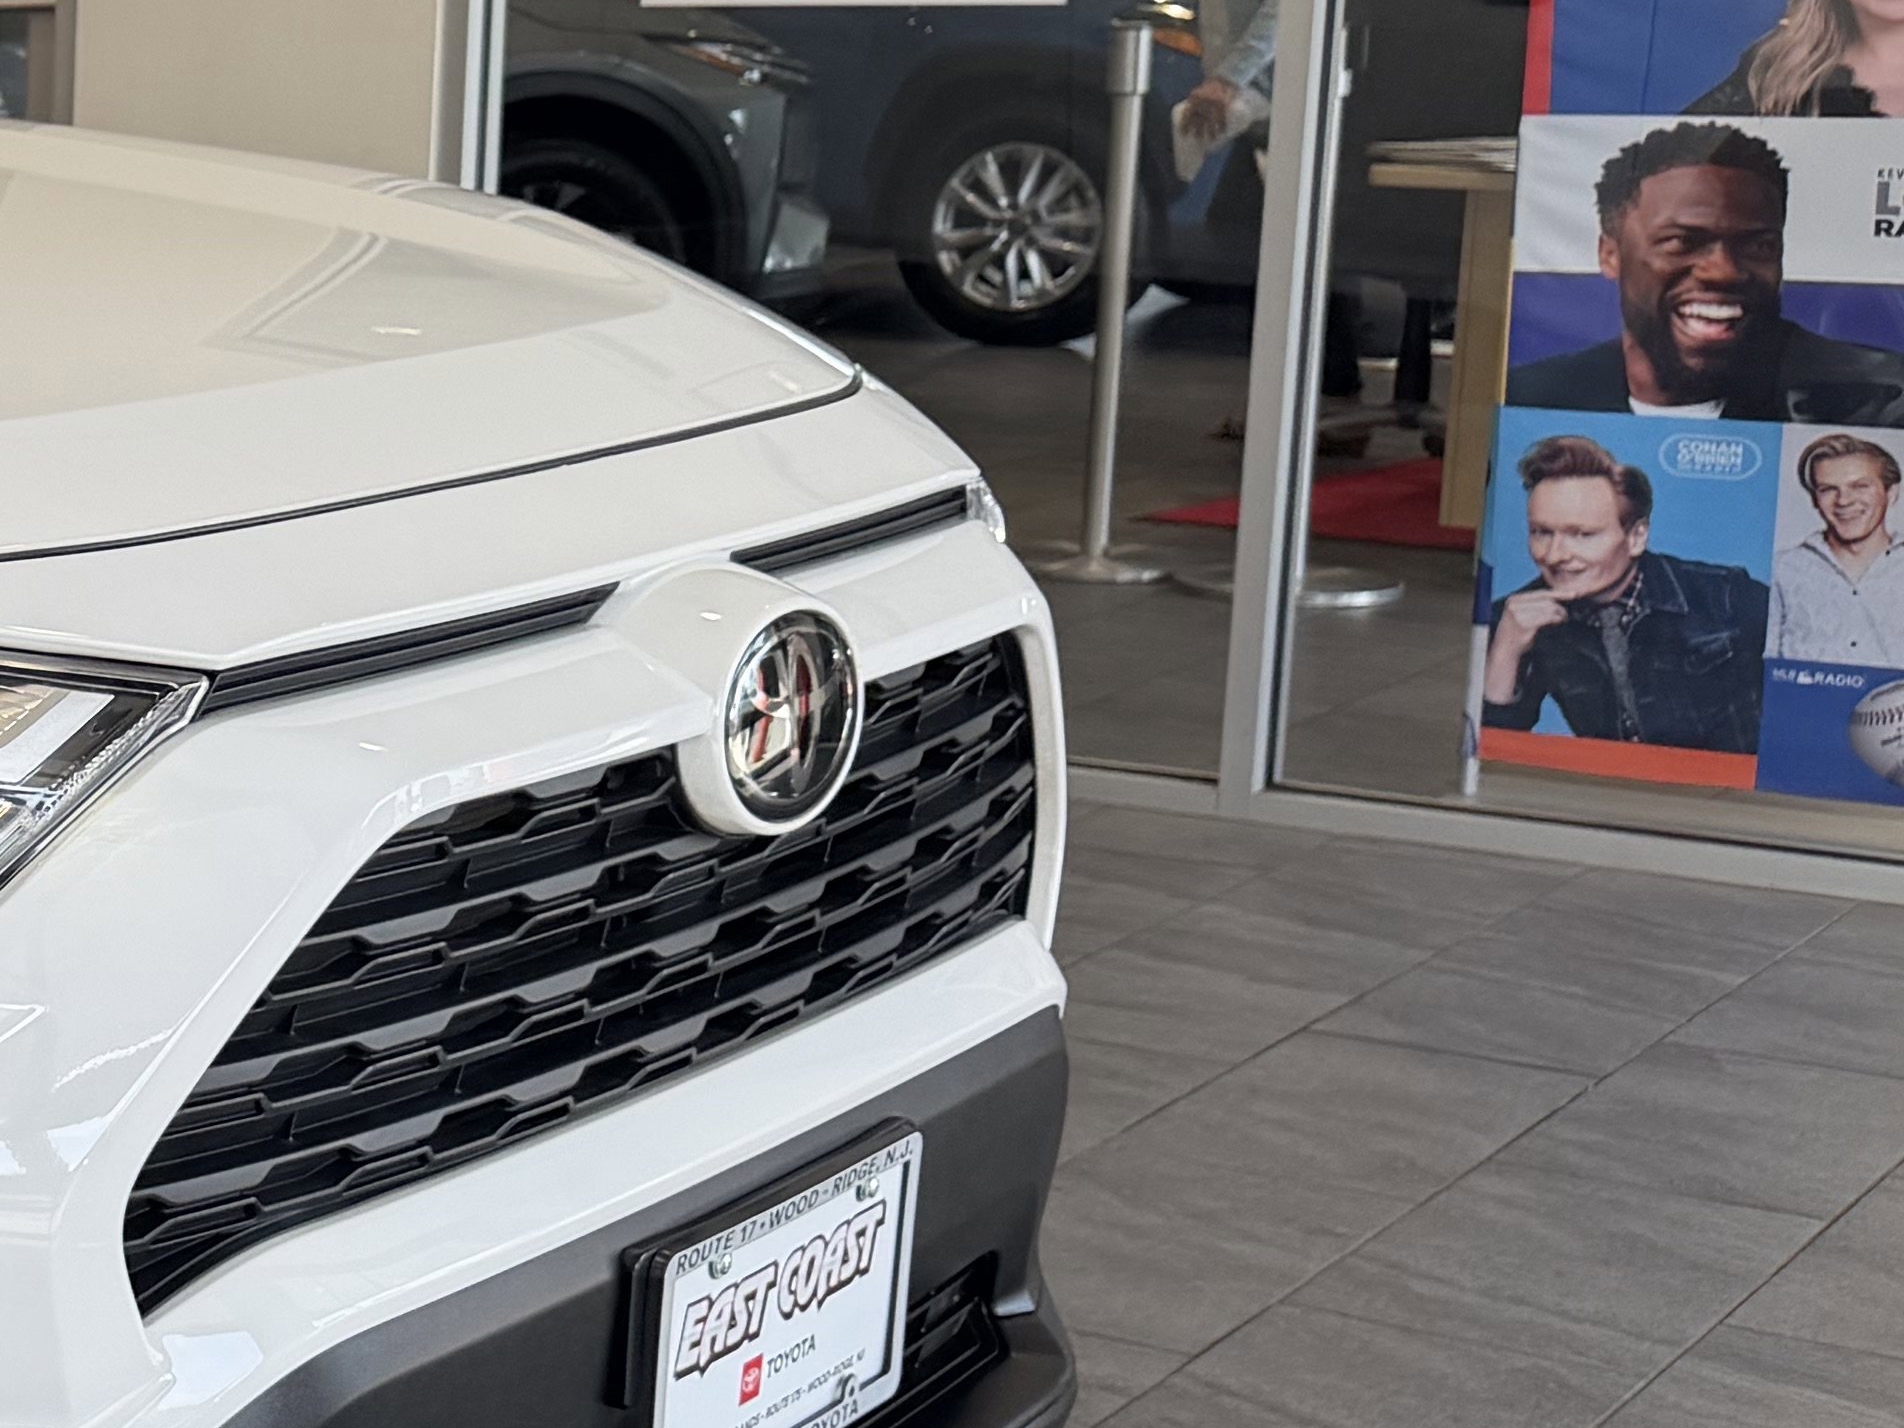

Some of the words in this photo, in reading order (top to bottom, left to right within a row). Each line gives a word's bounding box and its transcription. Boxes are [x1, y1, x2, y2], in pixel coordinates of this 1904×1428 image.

[1813, 672, 1865, 688] RADIO
[676, 1230, 734, 1275] ROUTE
[741, 1223, 756, 1244] 17
[884, 1140, 913, 1168] N.J.
[674, 1260, 779, 1380] EAST
[777, 1198, 886, 1321] COAST
[767, 1333, 816, 1378] TOYOTA
